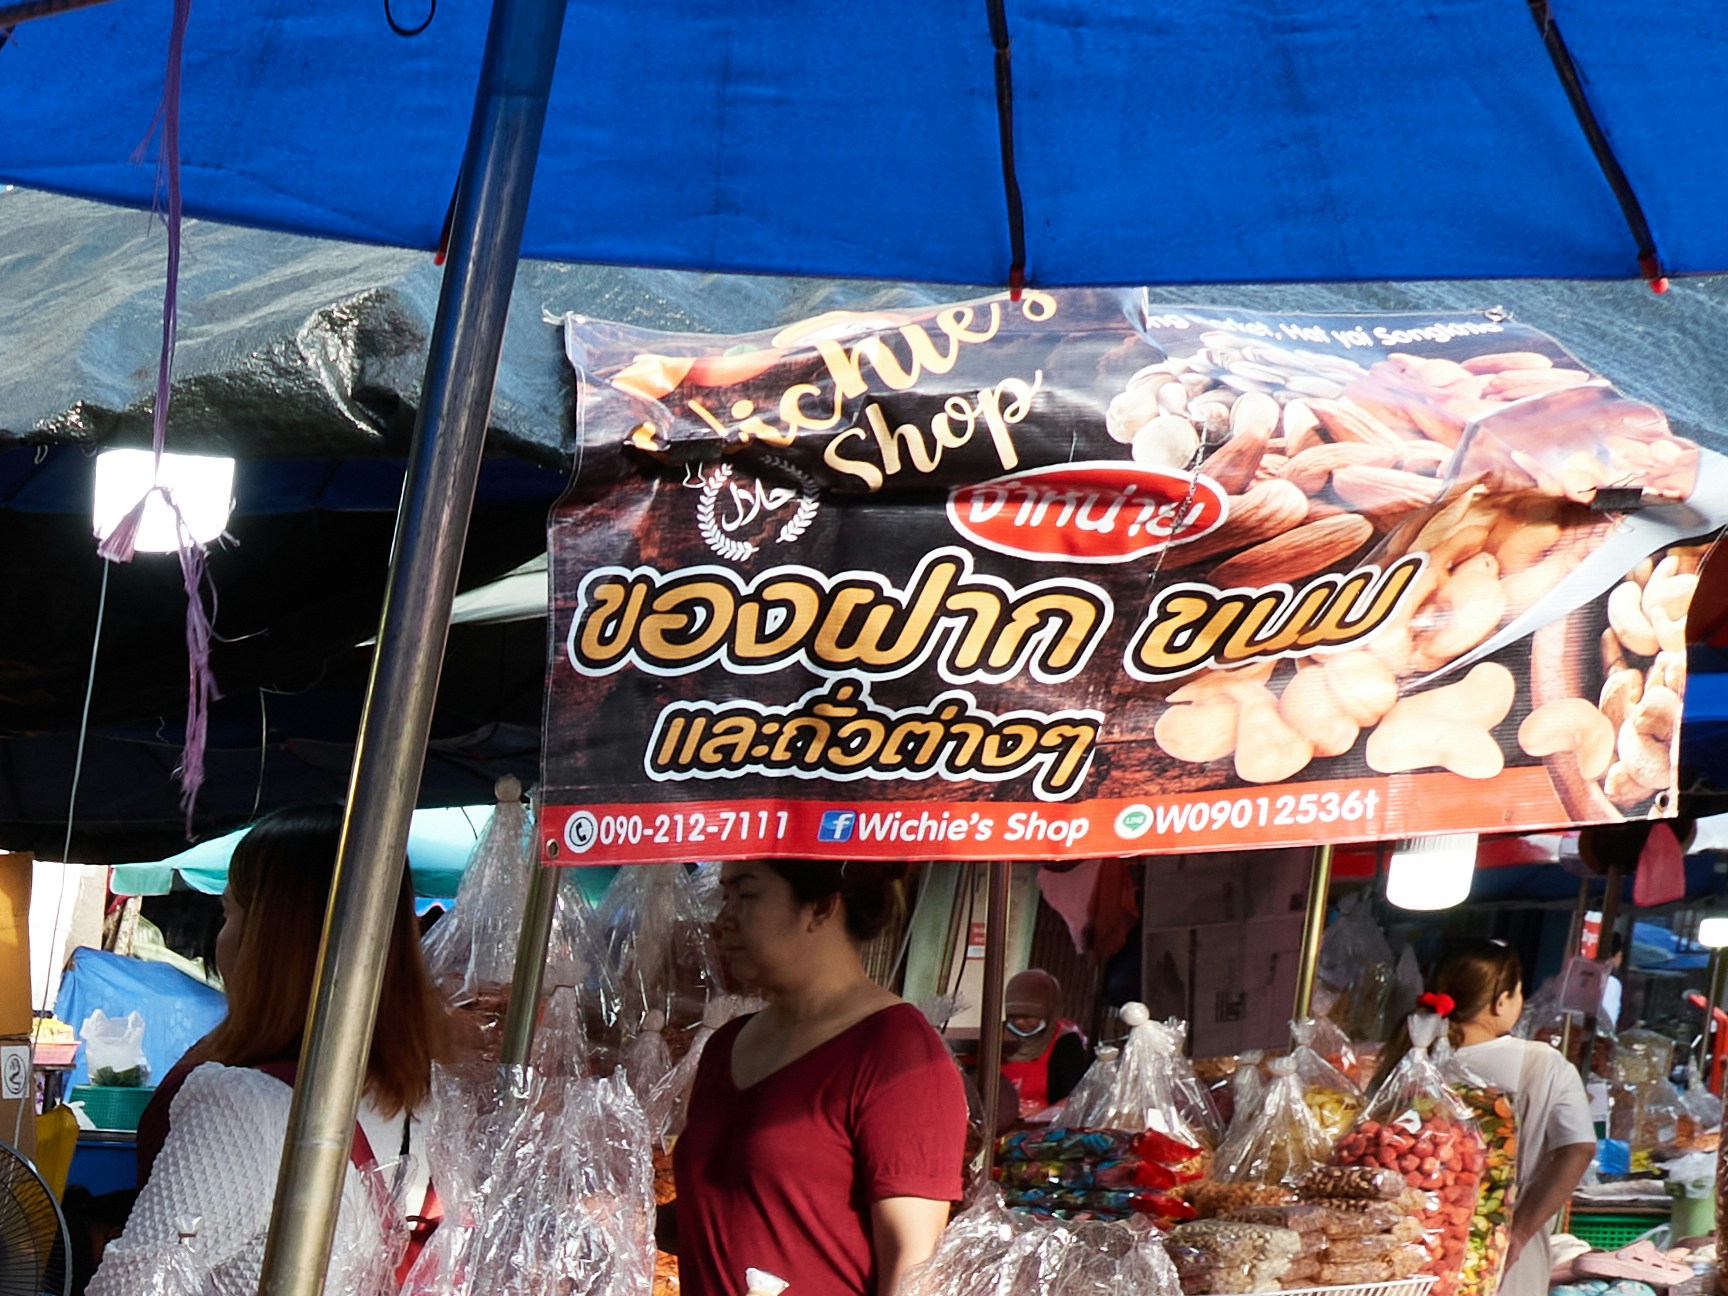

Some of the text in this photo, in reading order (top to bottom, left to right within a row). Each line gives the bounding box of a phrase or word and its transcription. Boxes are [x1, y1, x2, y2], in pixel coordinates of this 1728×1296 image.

[722, 475, 800, 530] حلال
[967, 482, 1204, 538] จำหน่าย
[574, 552, 1423, 677] ของฝาก ขนม
[650, 680, 1099, 795] และถั่วต่างๆ
[599, 810, 790, 845] 090-212-7111
[858, 809, 993, 842] Wichie's
[1003, 810, 1090, 848] Shop
